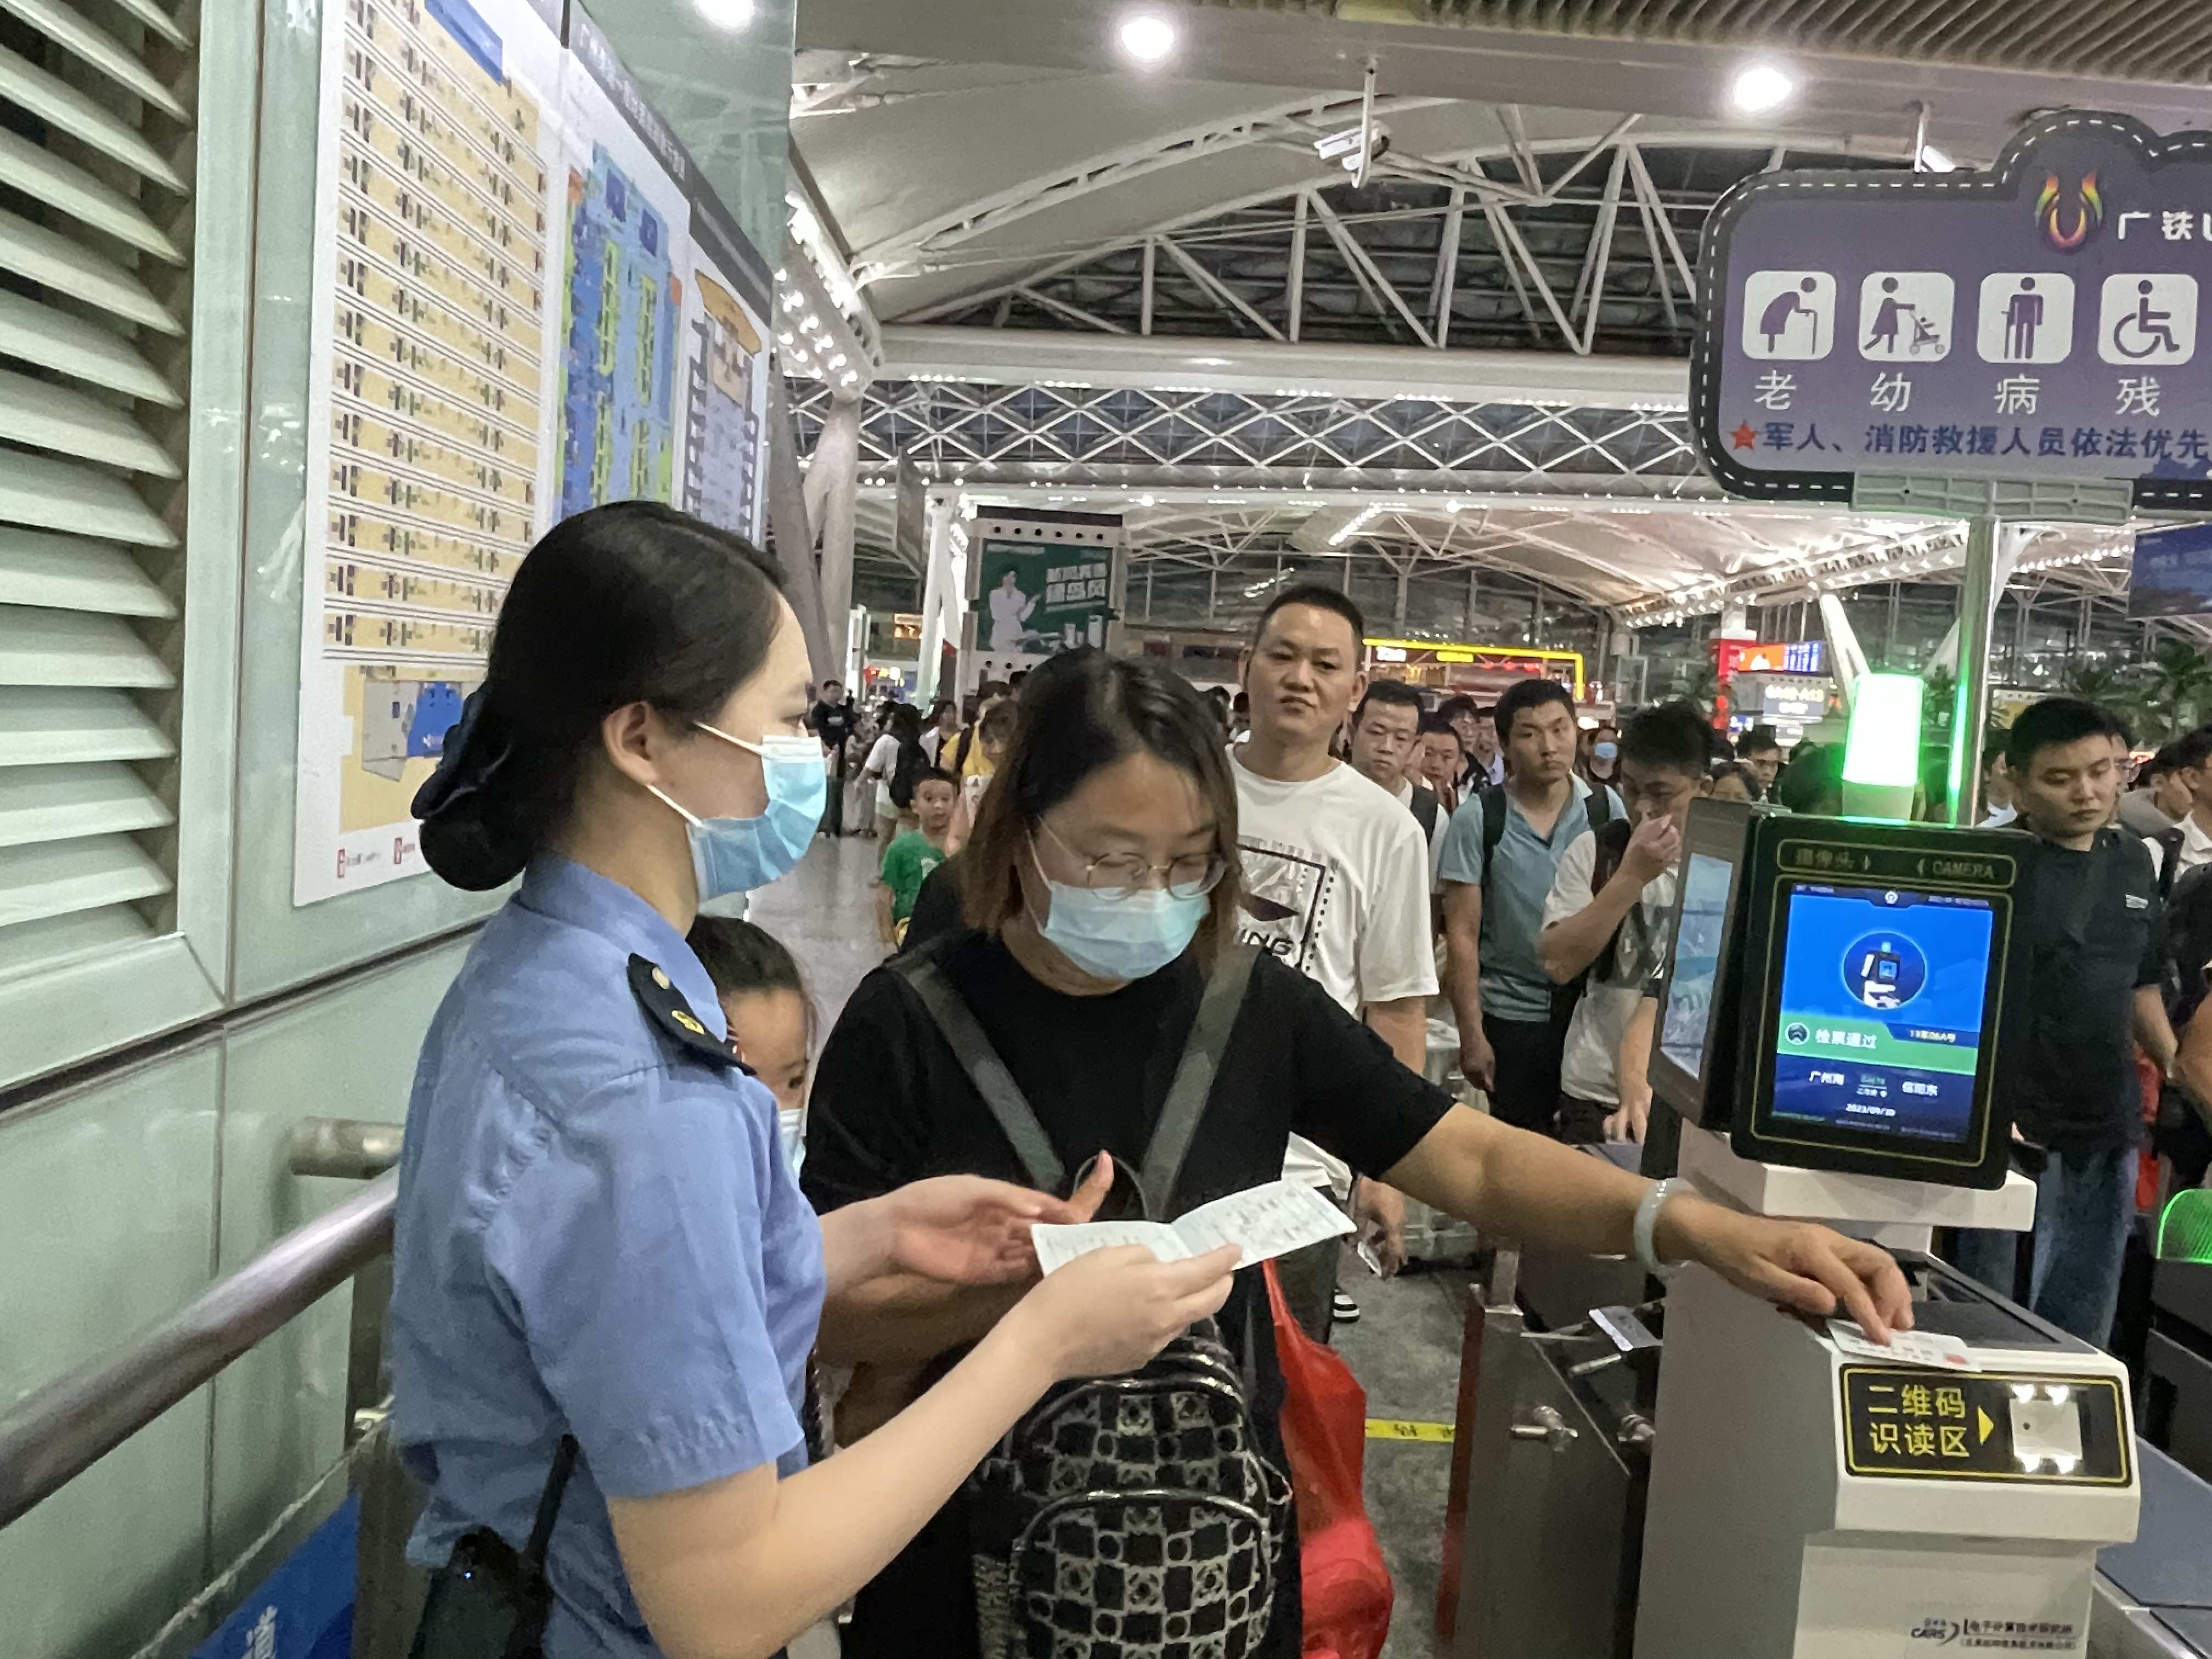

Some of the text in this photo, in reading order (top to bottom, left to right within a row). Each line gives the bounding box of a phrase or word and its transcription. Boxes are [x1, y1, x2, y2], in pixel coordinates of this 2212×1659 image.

[1754, 370, 2162, 417] 老 幼 病 残
[1932, 859, 1995, 879] CAMERA
[1867, 1384, 1967, 1420] 二维码
[1869, 1422, 1970, 1458] 识读区
